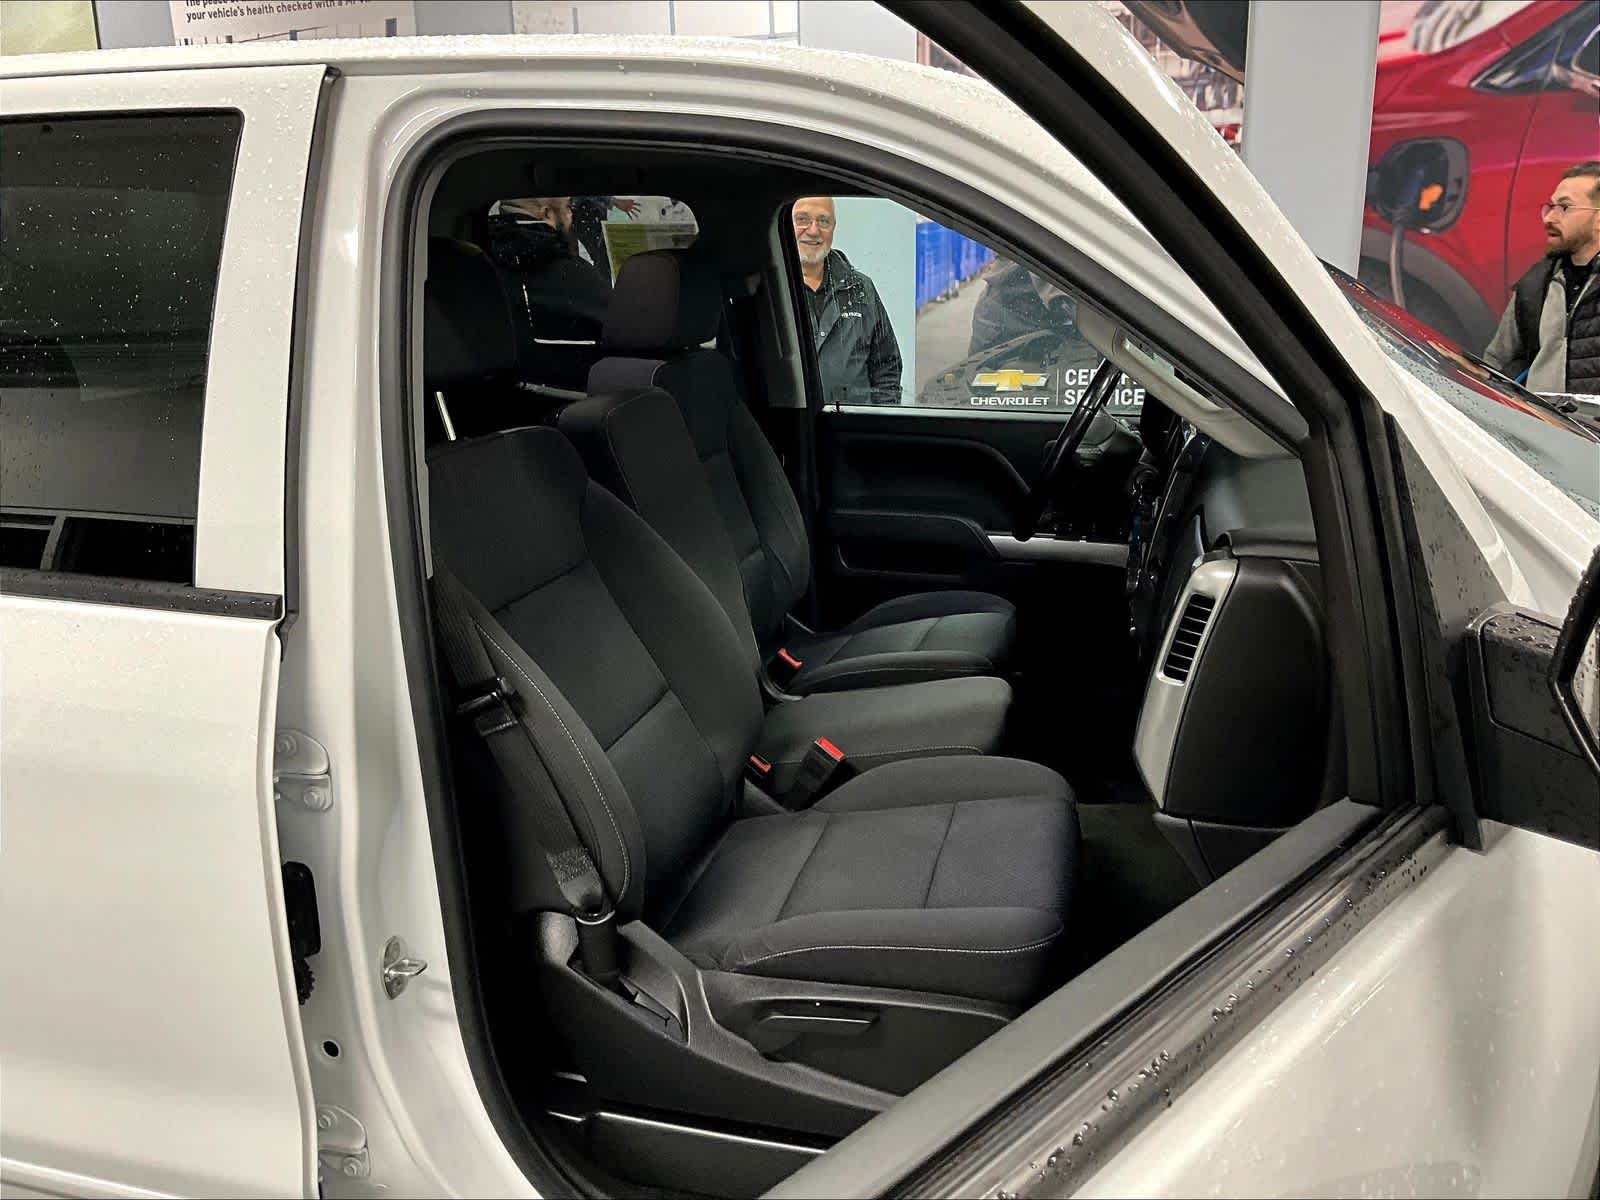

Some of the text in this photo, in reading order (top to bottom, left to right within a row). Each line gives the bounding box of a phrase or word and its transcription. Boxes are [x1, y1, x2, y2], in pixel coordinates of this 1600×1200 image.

[186, 12, 206, 23] your
[207, 6, 245, 19] vehicle's
[246, 3, 274, 16] health
[276, 1, 313, 13] checked
[315, 0, 336, 9] with
[970, 396, 1050, 406] CHEVROLET
[1064, 388, 1146, 406] SICE
